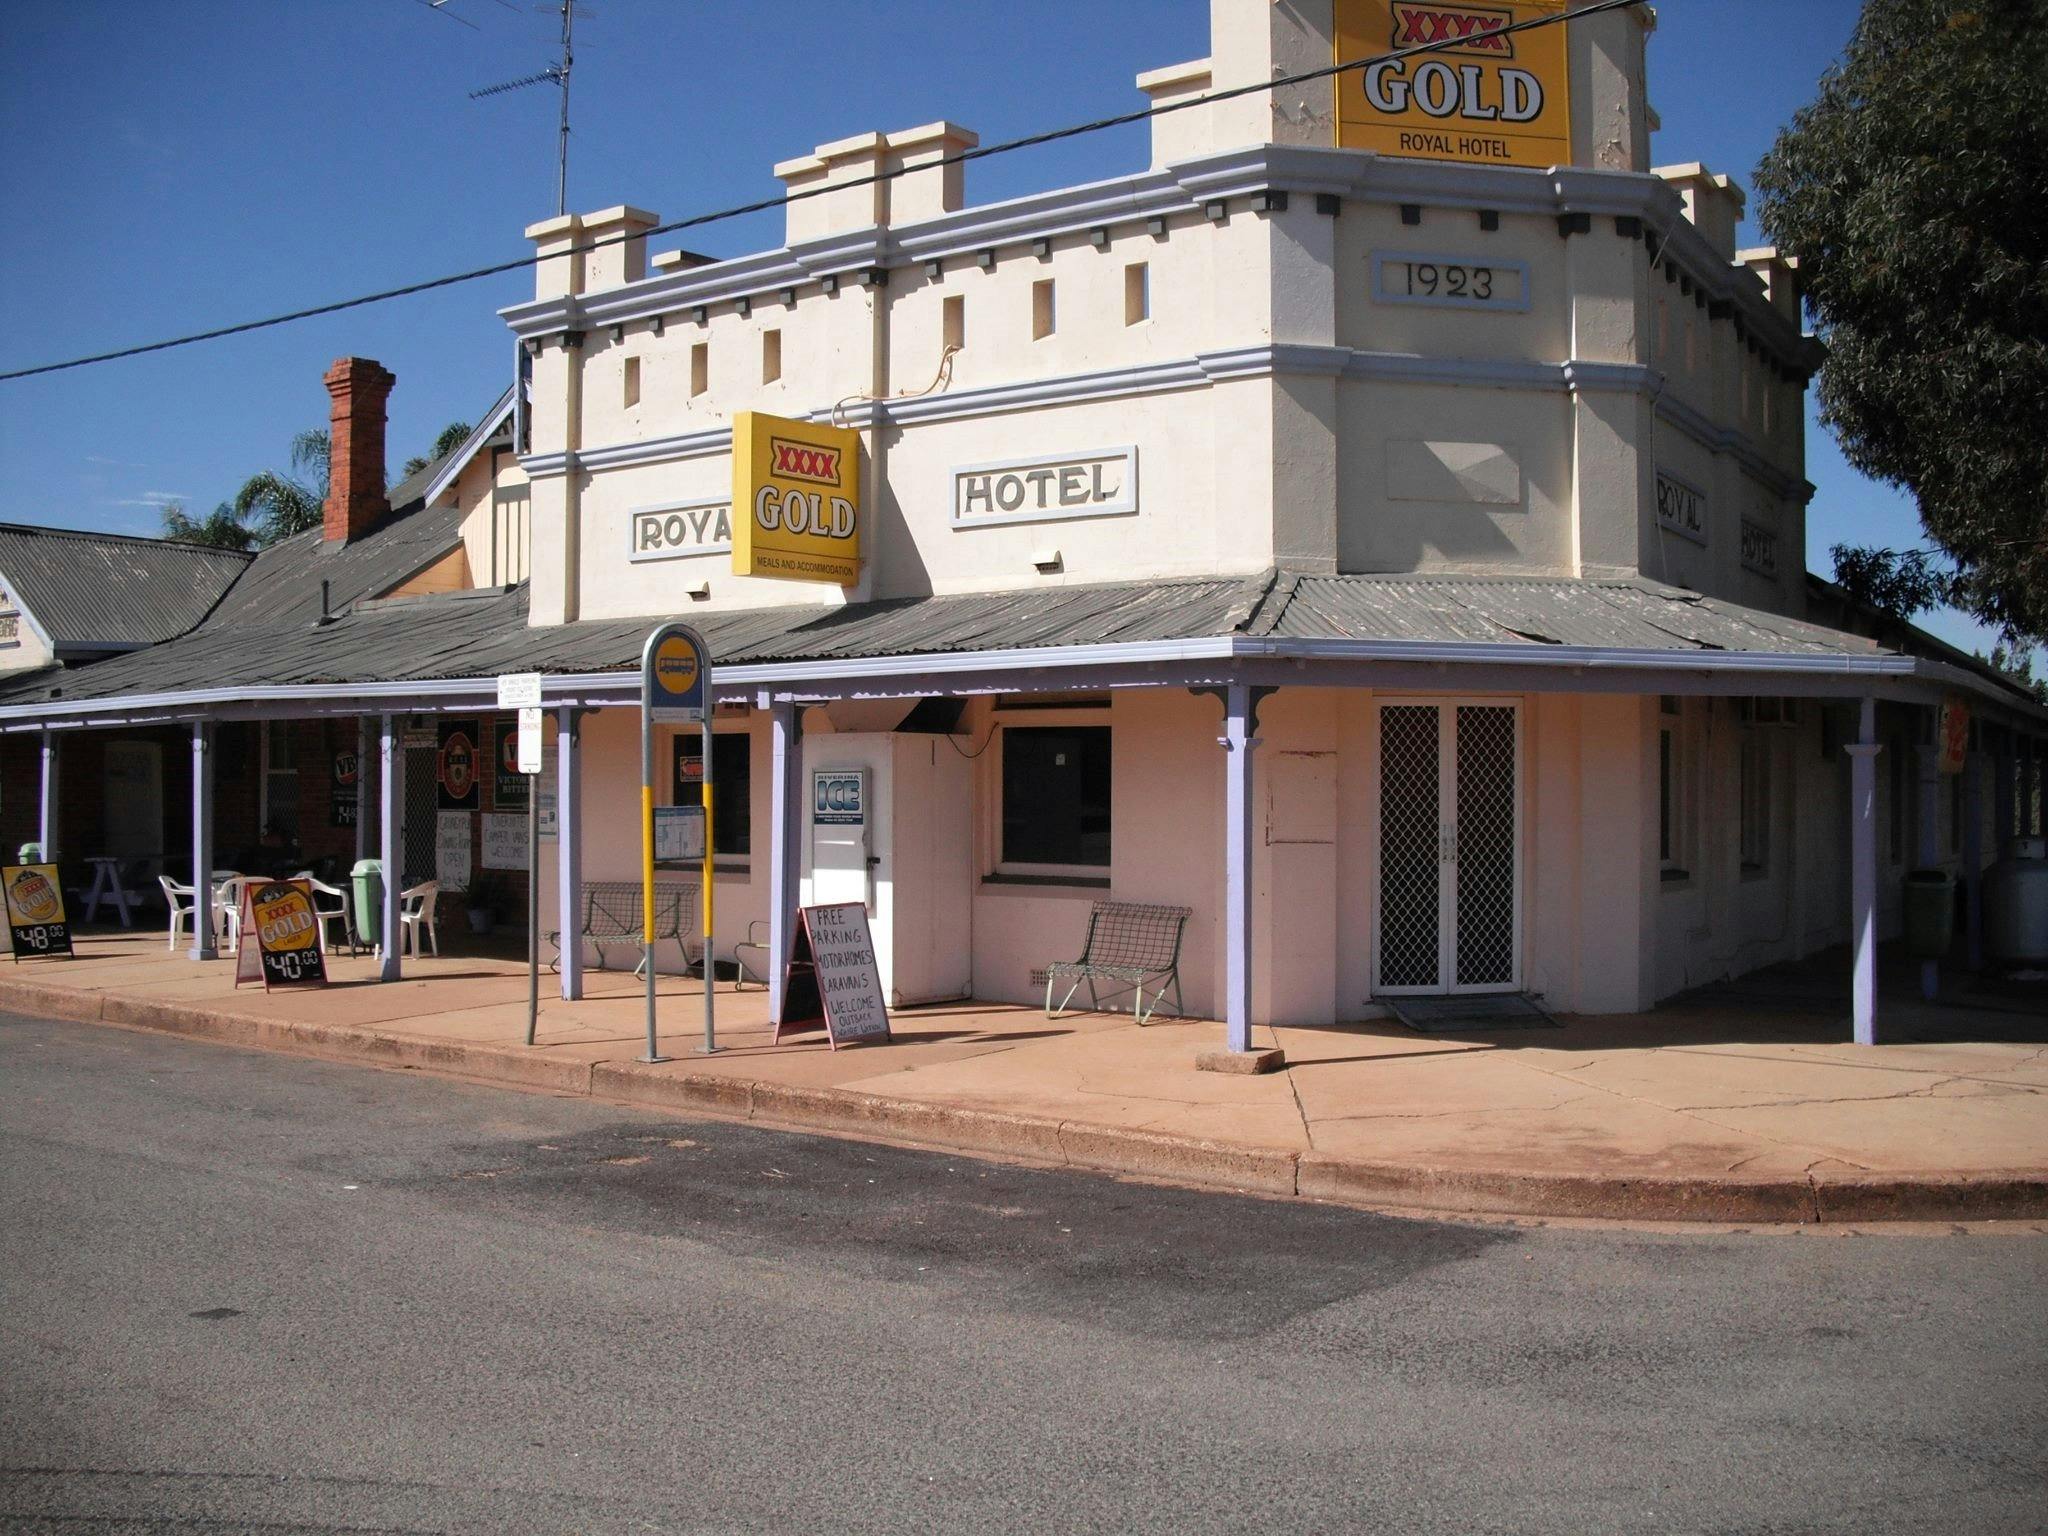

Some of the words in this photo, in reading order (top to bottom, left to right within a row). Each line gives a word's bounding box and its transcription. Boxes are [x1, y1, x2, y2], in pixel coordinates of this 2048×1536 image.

[1401, 9, 1504, 51] XXXX
[1364, 59, 1544, 123] GOLD
[1400, 133, 1454, 153] ROYAL
[1459, 138, 1511, 158] HOTEL
[1405, 262, 1493, 300] 1923
[776, 444, 838, 480] XXXX
[964, 463, 1120, 513] HOTEL
[1657, 478, 1700, 532] ROYAL
[639, 508, 732, 550] ROYA
[754, 484, 857, 540] GOLD
[757, 556, 780, 568] MEALS
[781, 560, 796, 570] AND
[796, 561, 854, 576] ACCOMMODATION
[817, 780, 860, 811] ICE
[261, 911, 313, 943] GOLD
[816, 908, 846, 926] FREE
[811, 929, 862, 945] PARKING
[822, 973, 869, 993] CARAVANS
[830, 996, 876, 1015] WELCOME
